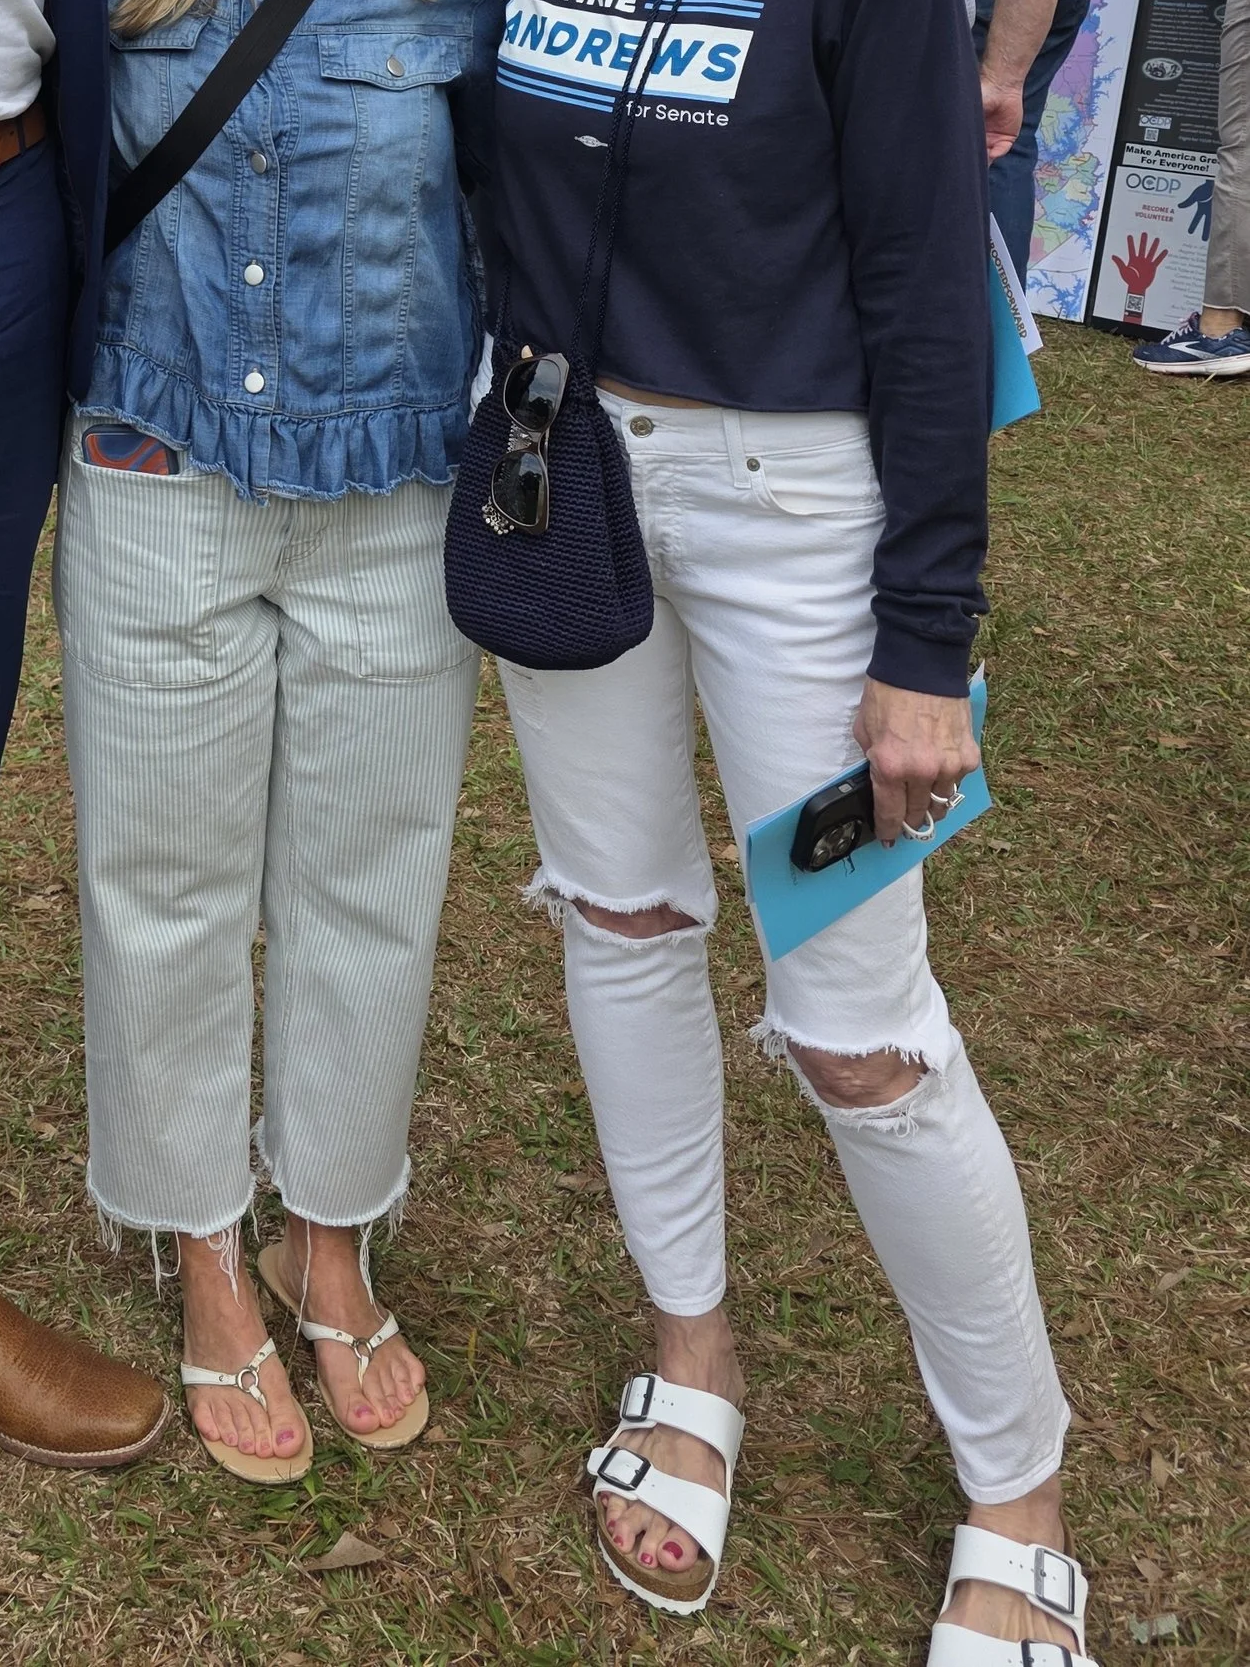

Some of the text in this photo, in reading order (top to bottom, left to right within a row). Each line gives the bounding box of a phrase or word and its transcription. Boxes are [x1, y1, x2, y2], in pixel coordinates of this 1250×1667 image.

[505, 10, 741, 83] ANDREWS
[626, 100, 730, 127] for Senate
[1141, 116, 1171, 128] OCDP
[1126, 145, 1221, 165] Make America Gre
[1141, 156, 1209, 172] For Everyone!
[1126, 173, 1181, 194] OCDP
[1135, 211, 1174, 223] VOLUNTEER
[1142, 204, 1169, 214] BECOME
